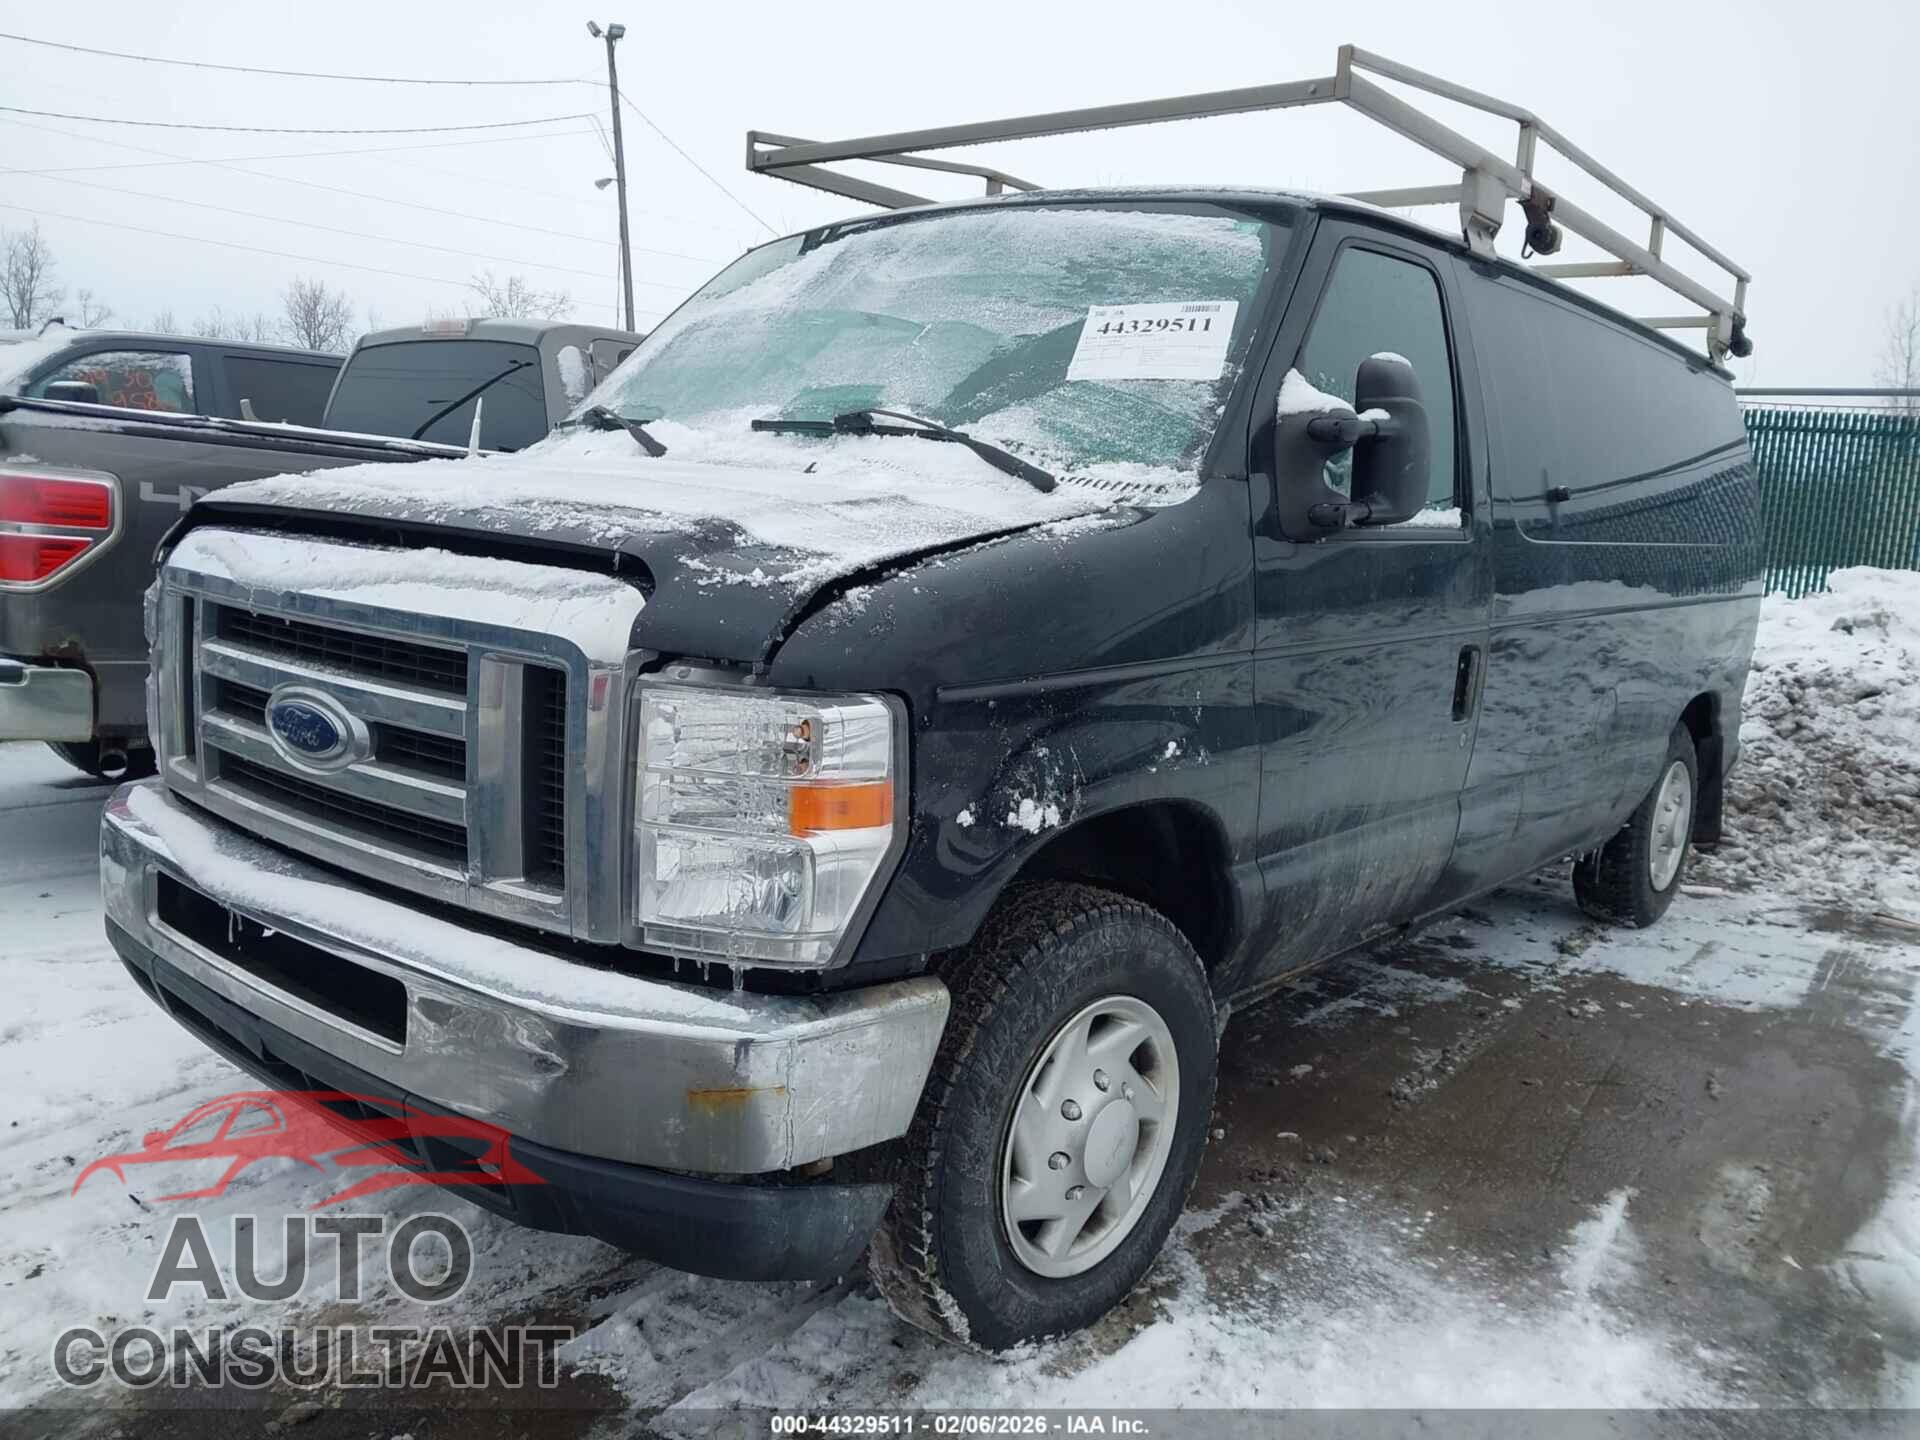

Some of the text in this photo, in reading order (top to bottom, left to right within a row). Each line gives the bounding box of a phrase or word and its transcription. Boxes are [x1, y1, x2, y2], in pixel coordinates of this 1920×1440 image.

[1097, 317, 1212, 335] 44329511
[139, 481, 210, 512] 4
[279, 707, 324, 746] Ford
